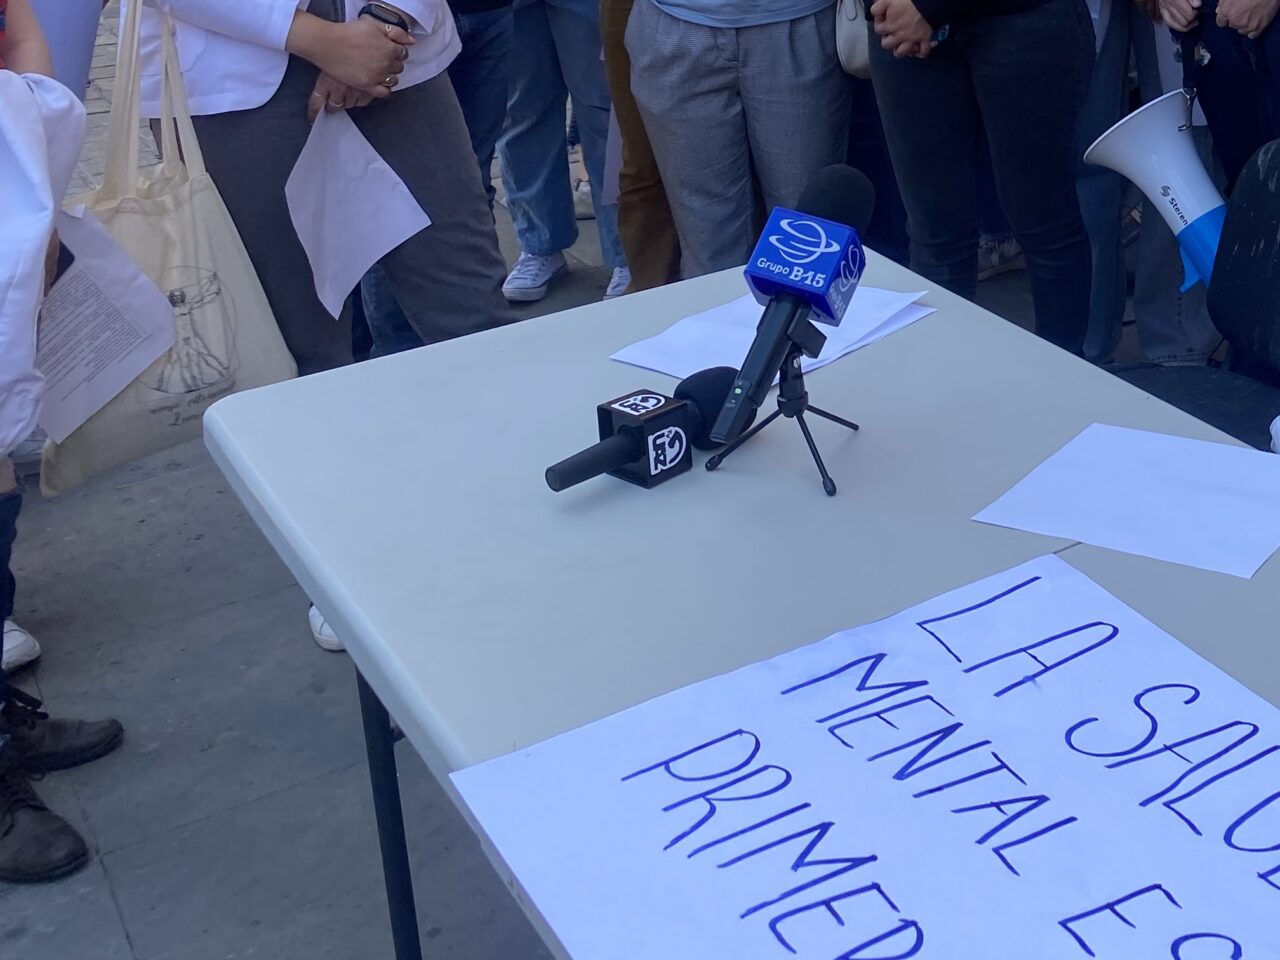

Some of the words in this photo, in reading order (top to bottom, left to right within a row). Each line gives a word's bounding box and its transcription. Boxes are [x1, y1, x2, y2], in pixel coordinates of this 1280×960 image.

[1169, 197, 1188, 226] Steren
[757, 257, 790, 275] Grupo
[915, 575, 1120, 698] LA
[780, 652, 1078, 876] MENTAL
